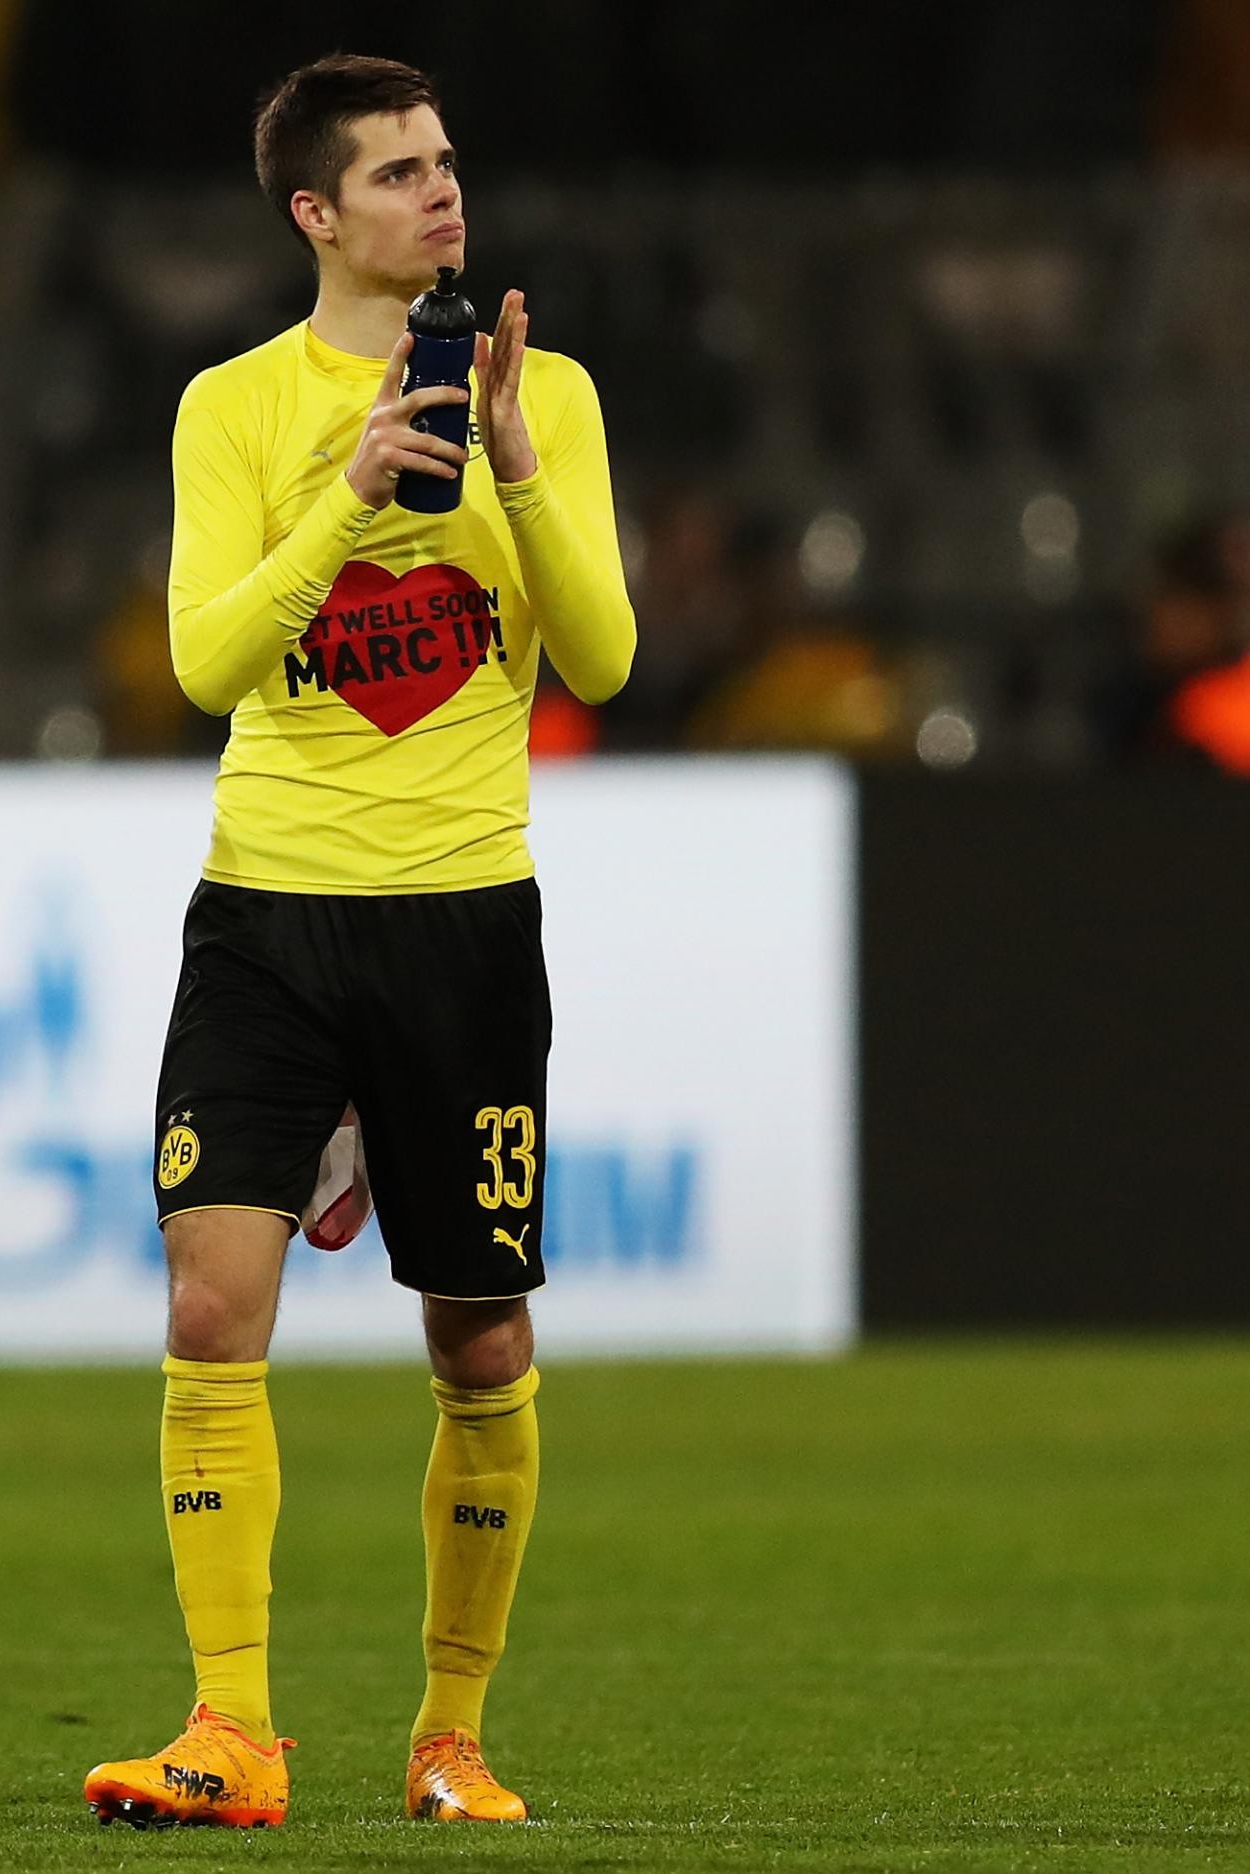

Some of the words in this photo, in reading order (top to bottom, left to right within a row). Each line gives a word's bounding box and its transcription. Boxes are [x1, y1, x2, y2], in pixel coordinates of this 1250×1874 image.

[300, 615, 332, 643] ET
[339, 600, 422, 634] WELL
[429, 587, 499, 622] SOON
[284, 627, 443, 698] MARC
[453, 616, 508, 668] !!!
[162, 1132, 193, 1172] BVB
[475, 1105, 536, 1210] 33
[174, 1490, 223, 1514] BVB
[454, 1504, 507, 1529] BVB
